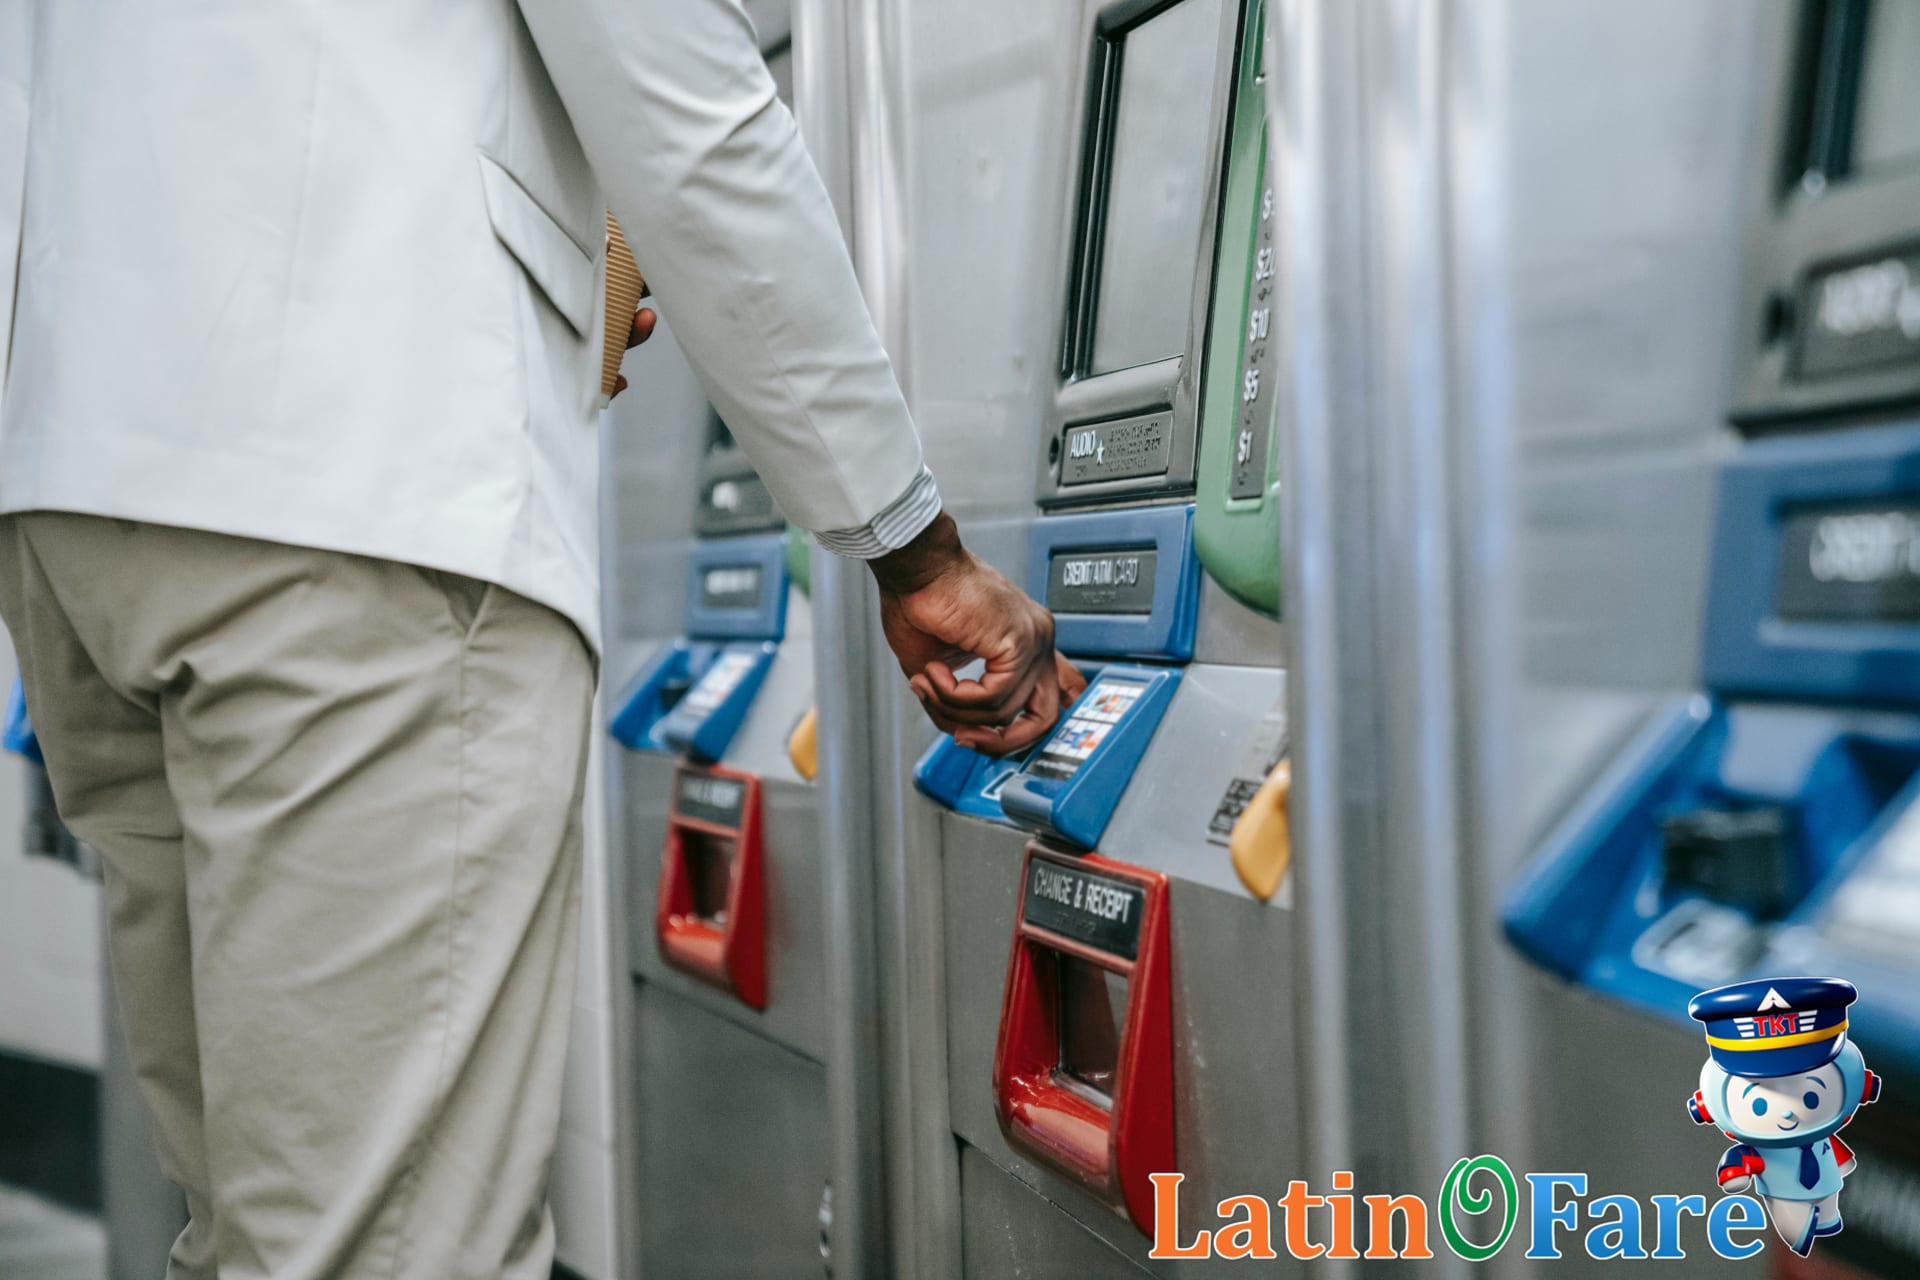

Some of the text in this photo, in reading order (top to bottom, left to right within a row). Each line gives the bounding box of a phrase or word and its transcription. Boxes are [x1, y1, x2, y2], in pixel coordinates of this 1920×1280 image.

[1249, 309, 1271, 341] $10
[1243, 369, 1261, 402] $5
[1070, 430, 1097, 458] AUDIO
[1238, 431, 1253, 463] $1
[1033, 867, 1134, 924] CHANGE & RECEIPT
